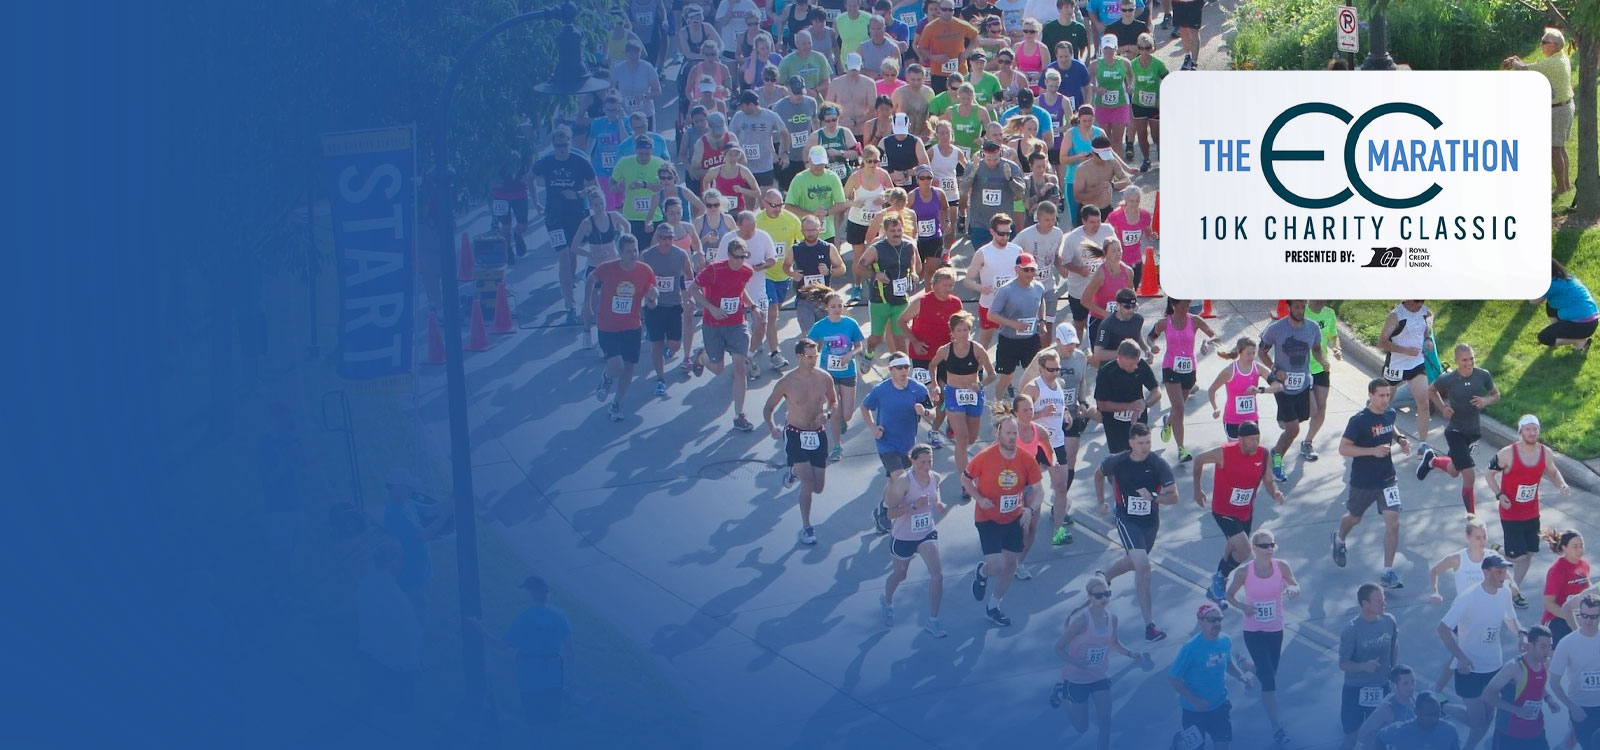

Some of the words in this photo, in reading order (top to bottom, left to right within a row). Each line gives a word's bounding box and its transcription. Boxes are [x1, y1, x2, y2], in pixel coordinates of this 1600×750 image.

[1104, 92, 1117, 101] 625
[793, 134, 807, 143] 360
[703, 155, 728, 169] COLF
[943, 181, 954, 189] 502
[636, 200, 650, 209] 531
[922, 225, 934, 233] 555
[1126, 234, 1137, 242] 435
[338, 163, 405, 368] START
[1177, 361, 1191, 369] 480
[1240, 401, 1253, 409] 403
[804, 437, 817, 445] 721
[1132, 502, 1147, 511] 532
[1258, 607, 1273, 616] 581
[1584, 675, 1600, 686] 431
[1364, 691, 1379, 701] 358
